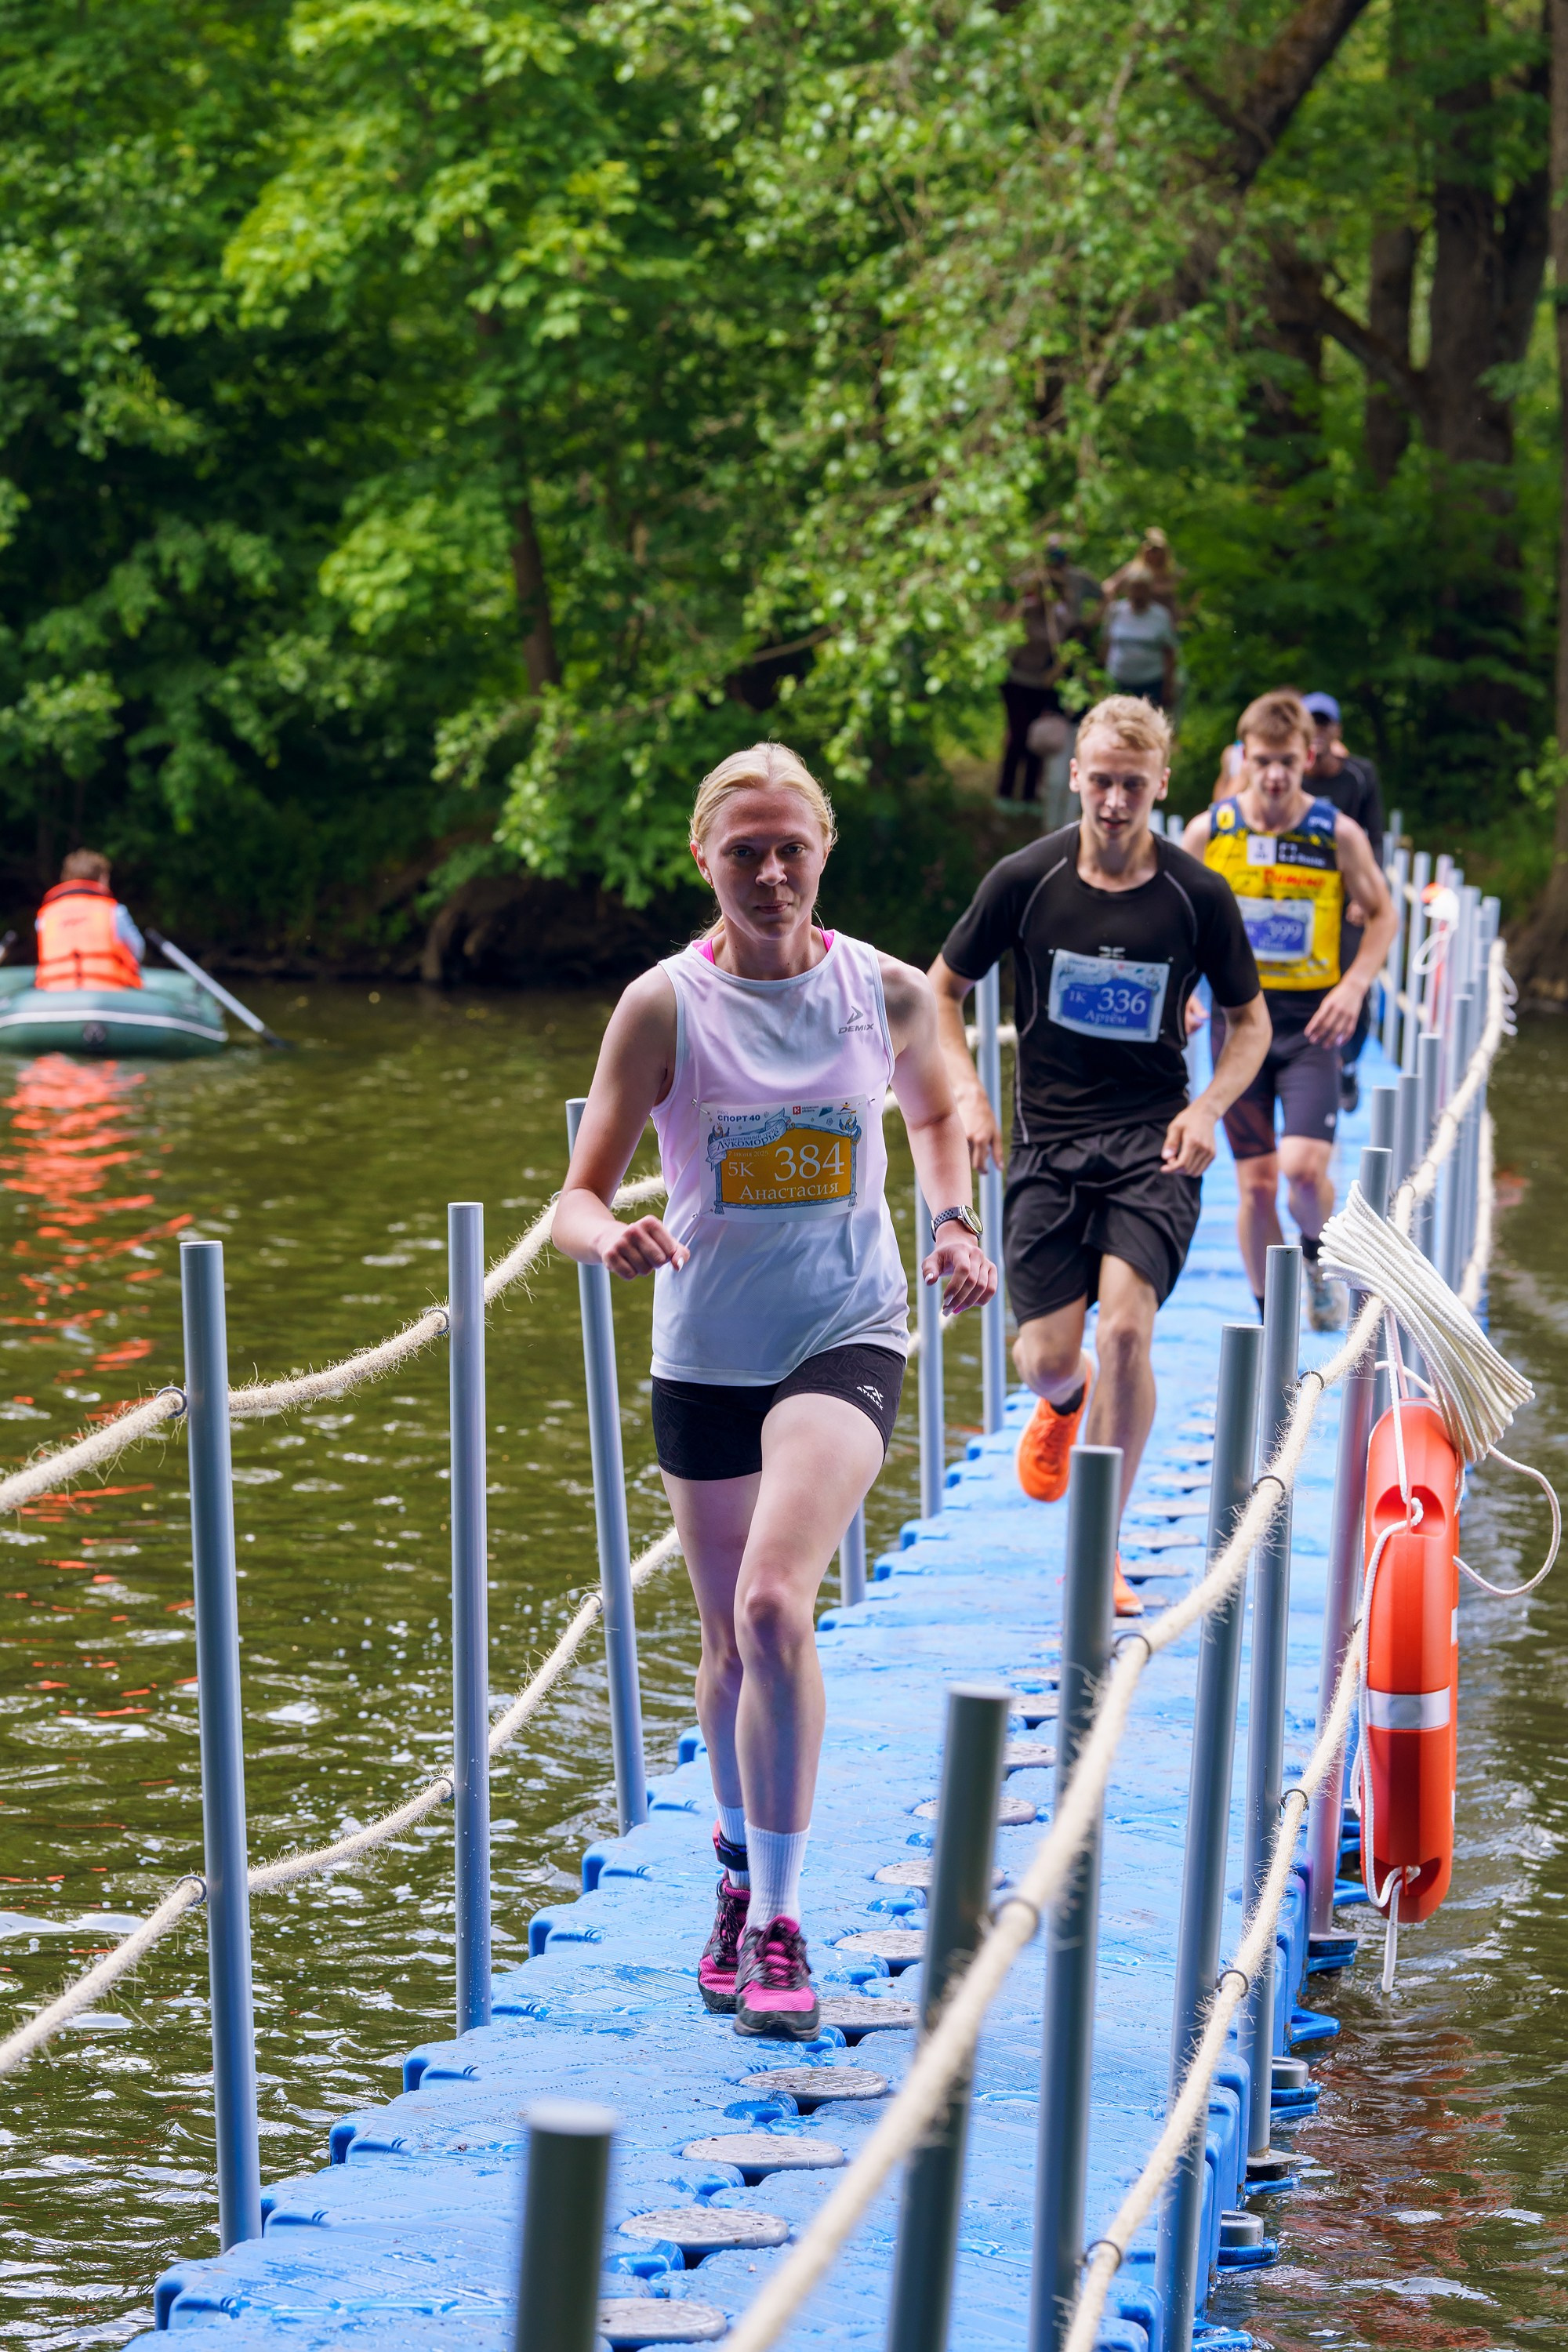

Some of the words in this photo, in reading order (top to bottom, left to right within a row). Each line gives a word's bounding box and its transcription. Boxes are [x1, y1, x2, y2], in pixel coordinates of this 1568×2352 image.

[1096, 987, 1147, 1015] 336
[838, 1023, 874, 1034] DEMIX
[717, 1131, 780, 1151] Лукоморье
[775, 1142, 845, 1181] 384
[739, 1181, 839, 1200] Анастасия
